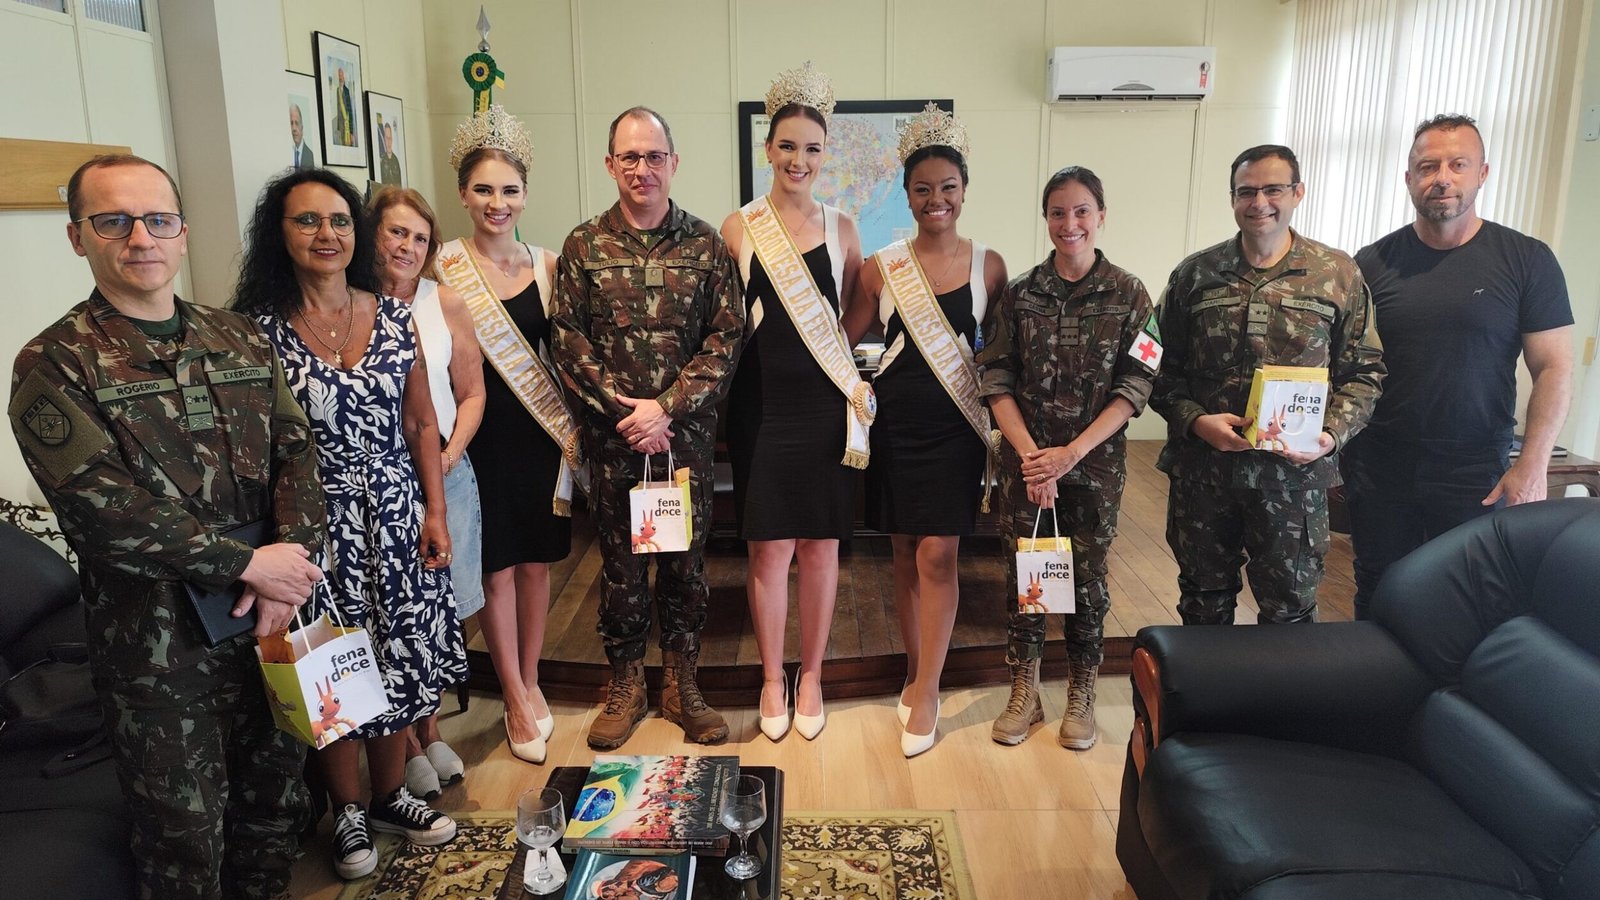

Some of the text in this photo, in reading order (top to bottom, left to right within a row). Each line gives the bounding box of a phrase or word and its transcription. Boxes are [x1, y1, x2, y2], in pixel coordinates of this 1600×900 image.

[750, 215, 857, 388] BARONESA DA FENADOCE
[444, 261, 510, 348] BARONESA
[496, 341, 528, 373] DA
[889, 266, 945, 347] BARONESA
[931, 341, 959, 371] DA
[223, 368, 261, 380] EXÉRCITO
[116, 382, 160, 396] ROGÉRIO
[1293, 393, 1321, 404] fena
[1287, 403, 1320, 414] doce
[657, 498, 680, 507] fena
[654, 507, 681, 517] doce
[1045, 561, 1069, 570] fena
[1041, 570, 1069, 580] doce
[331, 647, 367, 668] fena
[331, 658, 370, 682] doce
